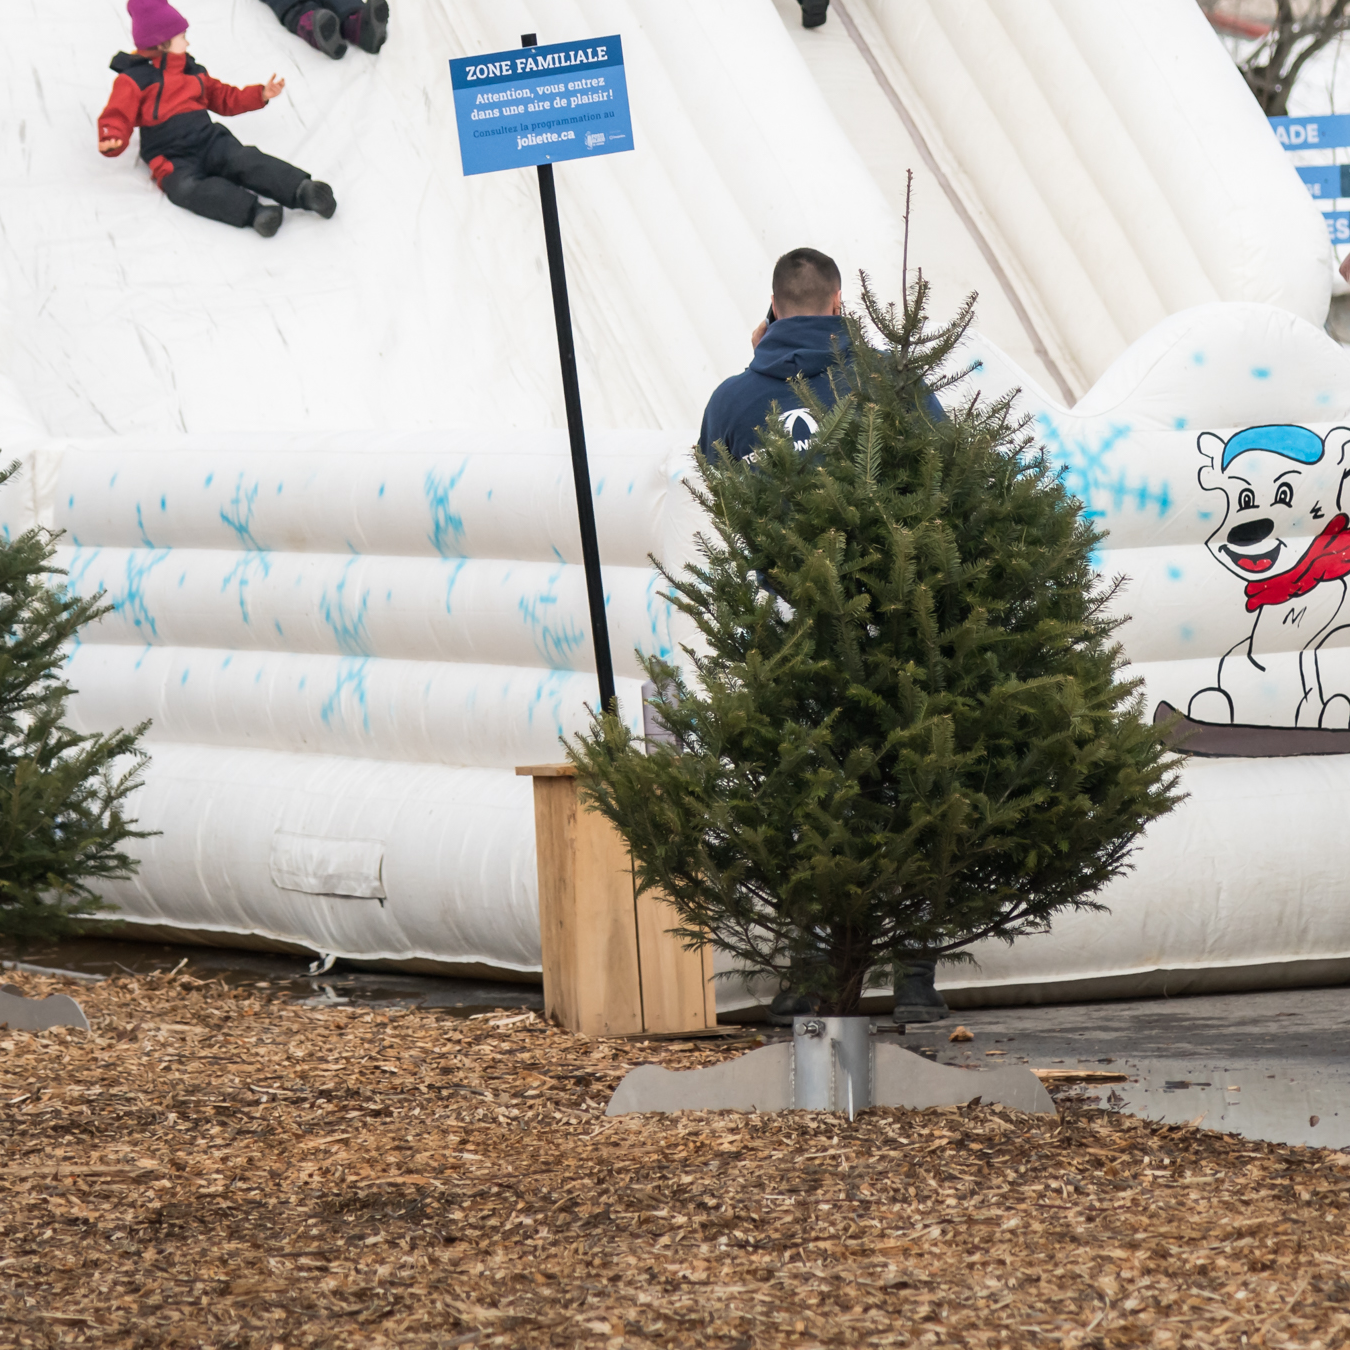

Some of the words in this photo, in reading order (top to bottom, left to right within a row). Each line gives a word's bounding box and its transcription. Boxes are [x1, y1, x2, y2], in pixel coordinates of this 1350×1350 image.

[465, 60, 512, 81] ZONE
[515, 46, 608, 73] FAMILIALE
[475, 87, 534, 105] Attention,
[536, 82, 565, 95] vous
[567, 77, 605, 91] entrez
[471, 108, 500, 121] dans
[502, 104, 525, 116] une
[527, 100, 550, 112] aire
[553, 96, 567, 108] de
[473, 125, 518, 138] Consultez
[520, 123, 529, 131] la
[531, 113, 601, 130] programmation
[604, 110, 615, 119] au
[517, 130, 575, 150] joliette.ca
